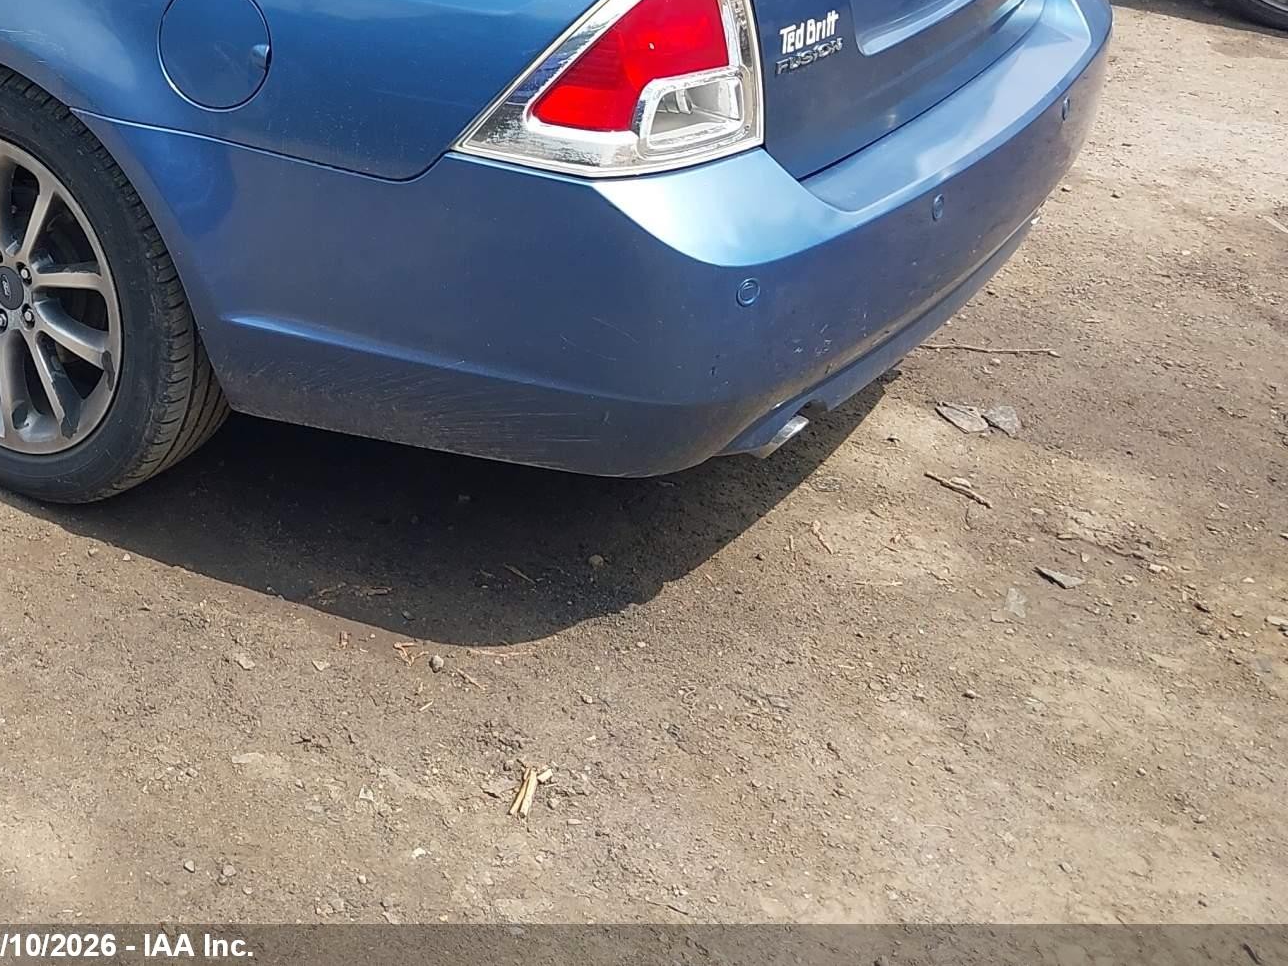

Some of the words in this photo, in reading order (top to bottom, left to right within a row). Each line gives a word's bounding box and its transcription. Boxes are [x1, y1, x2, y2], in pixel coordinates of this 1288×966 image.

[779, 22, 805, 54] Ted
[806, 10, 839, 46] Britt
[776, 38, 843, 75] FUSION
